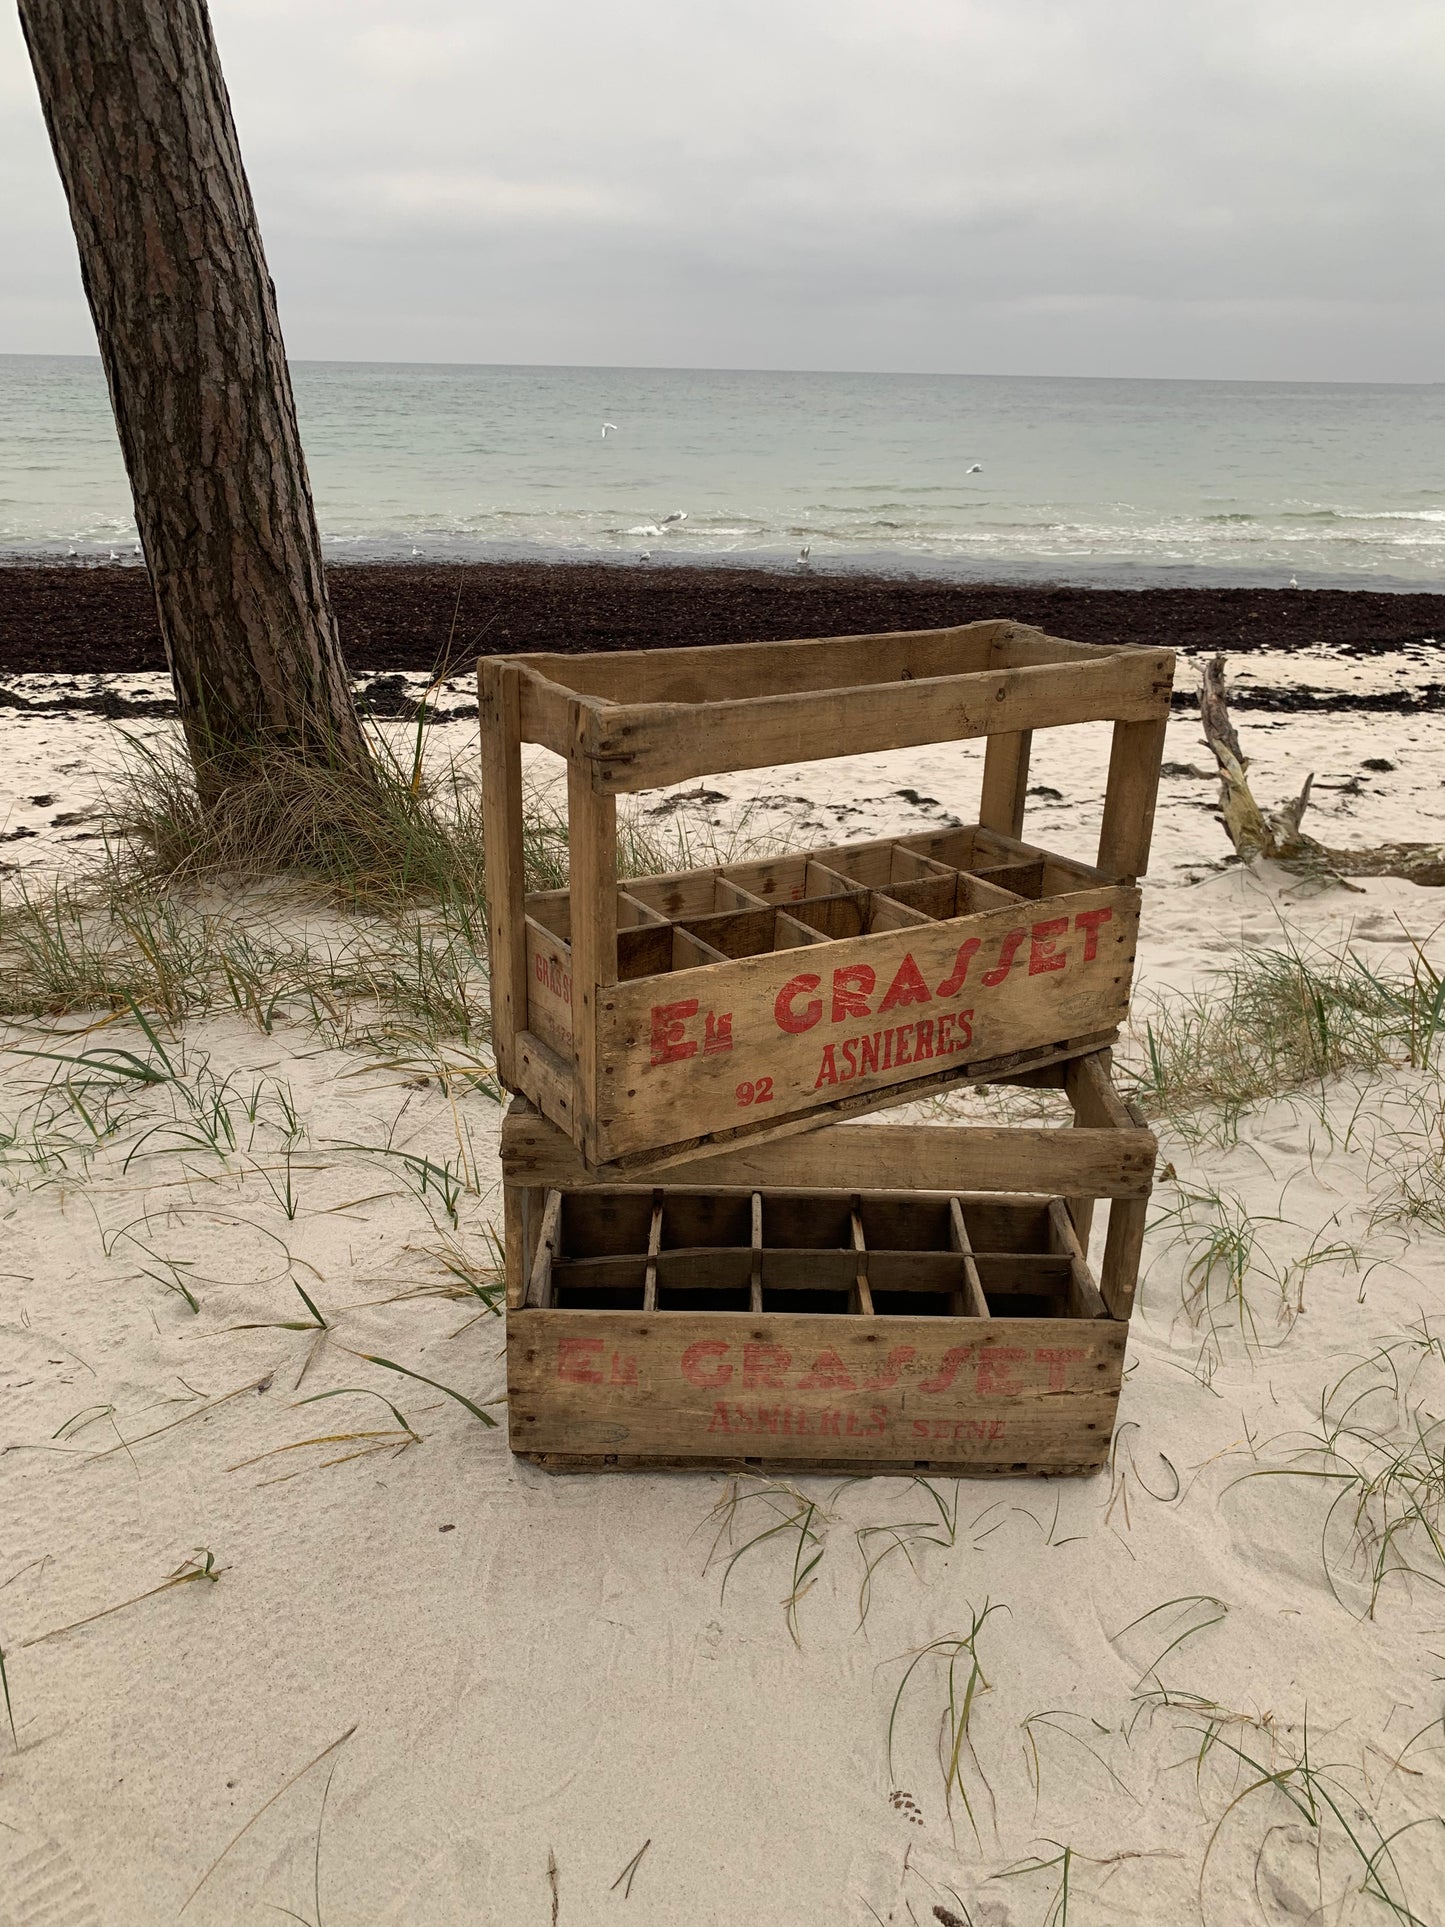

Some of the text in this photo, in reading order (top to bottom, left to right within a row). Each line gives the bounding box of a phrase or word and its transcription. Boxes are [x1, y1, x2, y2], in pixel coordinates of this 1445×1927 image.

[773, 907, 1113, 1035] GRASSET
[814, 1008, 975, 1089] ASNIERES
[735, 1075, 775, 1108] 92
[680, 1336, 1086, 1397] GRASSET
[706, 1399, 1006, 1441] ASNIERES SEINE
